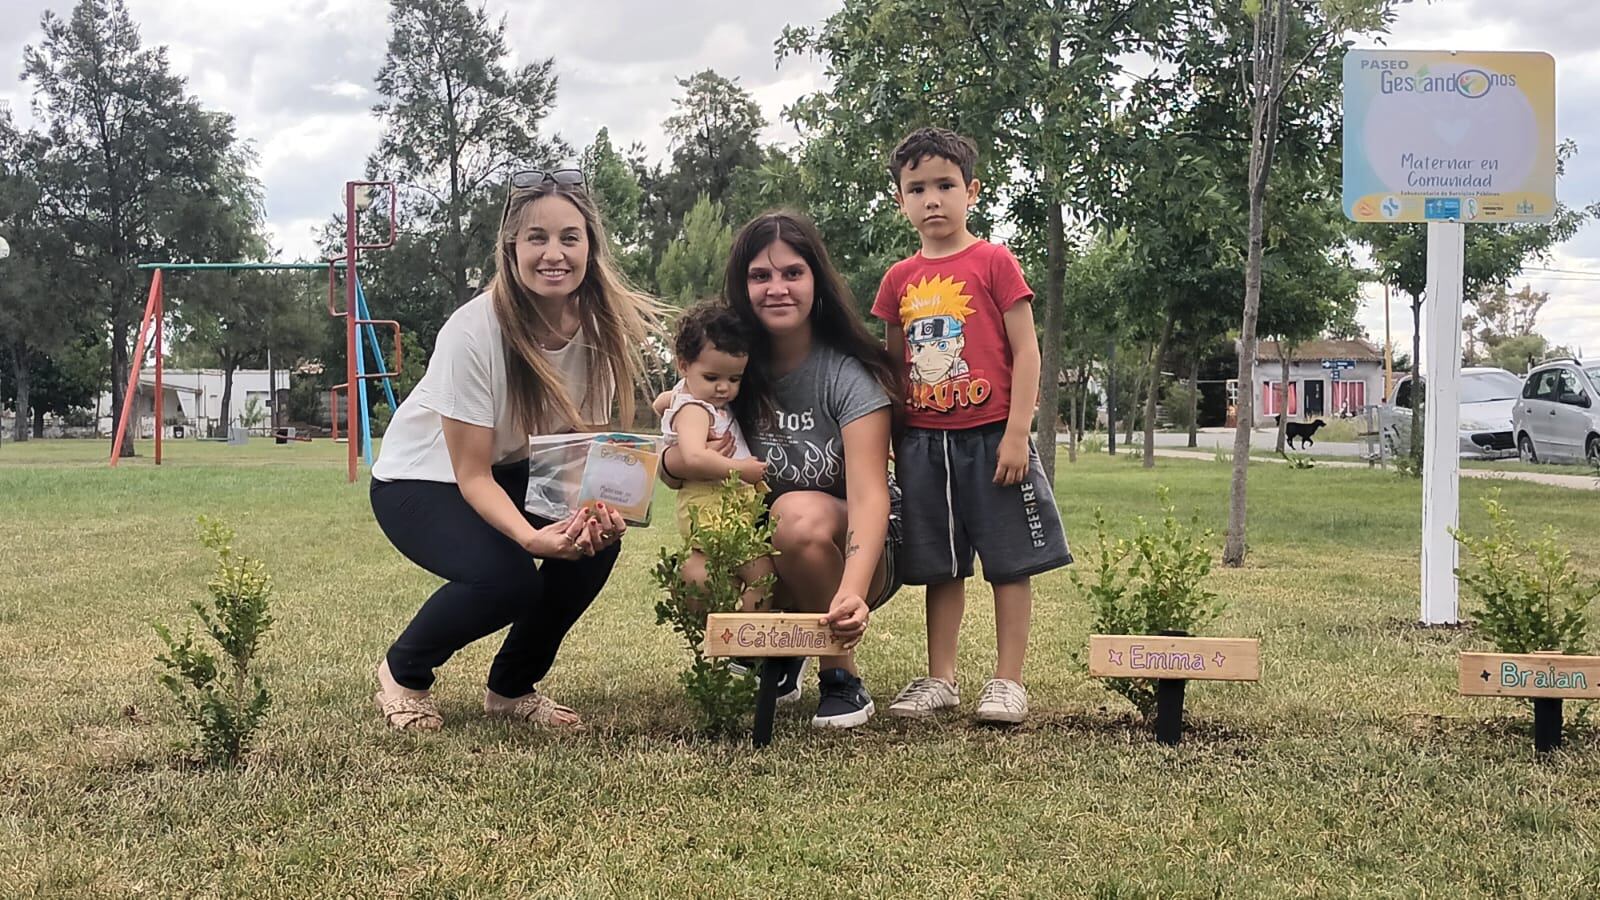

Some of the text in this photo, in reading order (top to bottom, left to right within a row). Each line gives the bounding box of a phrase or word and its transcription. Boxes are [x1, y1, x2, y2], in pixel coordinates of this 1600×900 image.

[1360, 59, 1409, 70] PASEO
[1401, 153, 1499, 171] Maternar en
[1407, 171, 1492, 187] Comunidad
[906, 378, 992, 413] RUTO
[737, 623, 827, 648] Catalina
[1130, 644, 1206, 671] Emma
[1500, 661, 1588, 689] Braian
